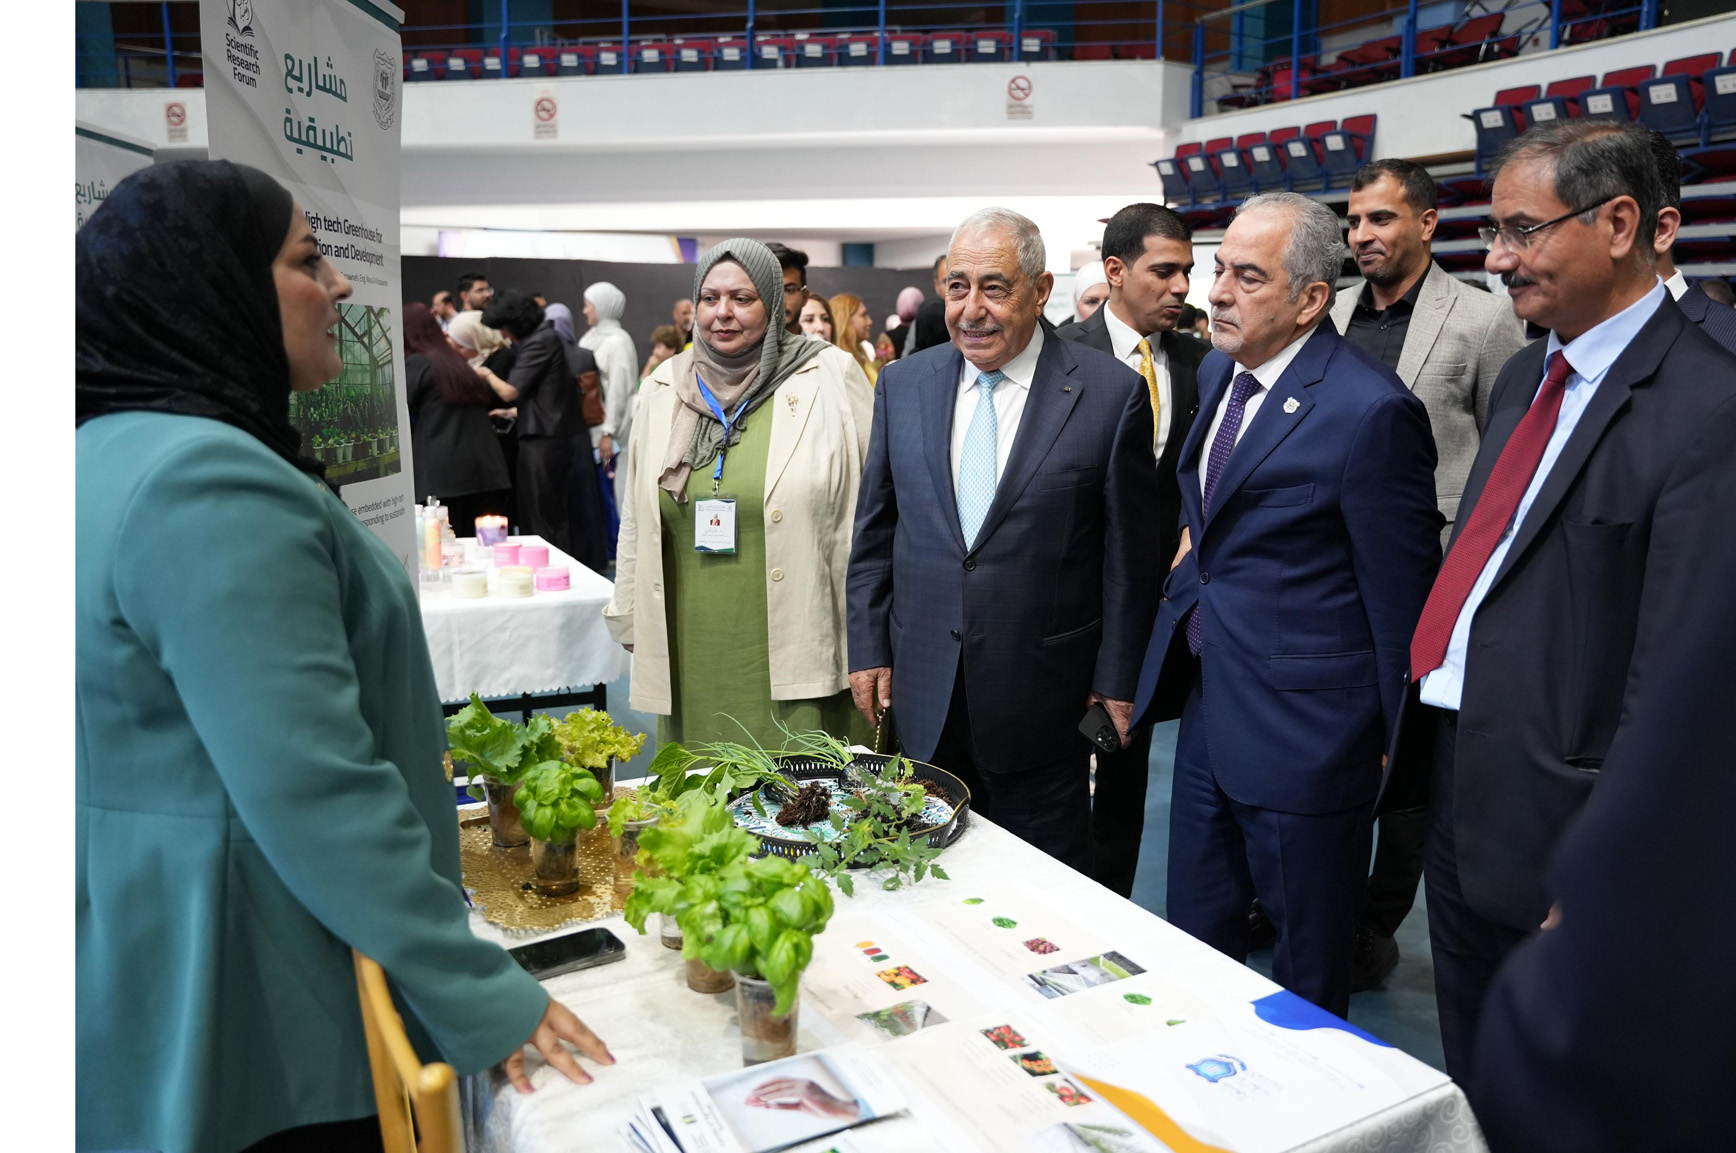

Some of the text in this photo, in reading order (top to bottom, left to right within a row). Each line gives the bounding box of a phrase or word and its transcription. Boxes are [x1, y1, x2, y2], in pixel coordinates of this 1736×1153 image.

[225, 33, 259, 60] Scientific
[227, 48, 261, 75] Research
[233, 66, 257, 88] Forum
[284, 53, 347, 103] مشاريع
[284, 107, 354, 164] تطبيقية
[75, 179, 109, 205] شاريع
[323, 215, 342, 234] tech
[343, 218, 375, 242] Greenhouse
[375, 227, 383, 244] for
[334, 242, 349, 259] and
[350, 244, 384, 267] Development
[358, 500, 382, 514] embedded
